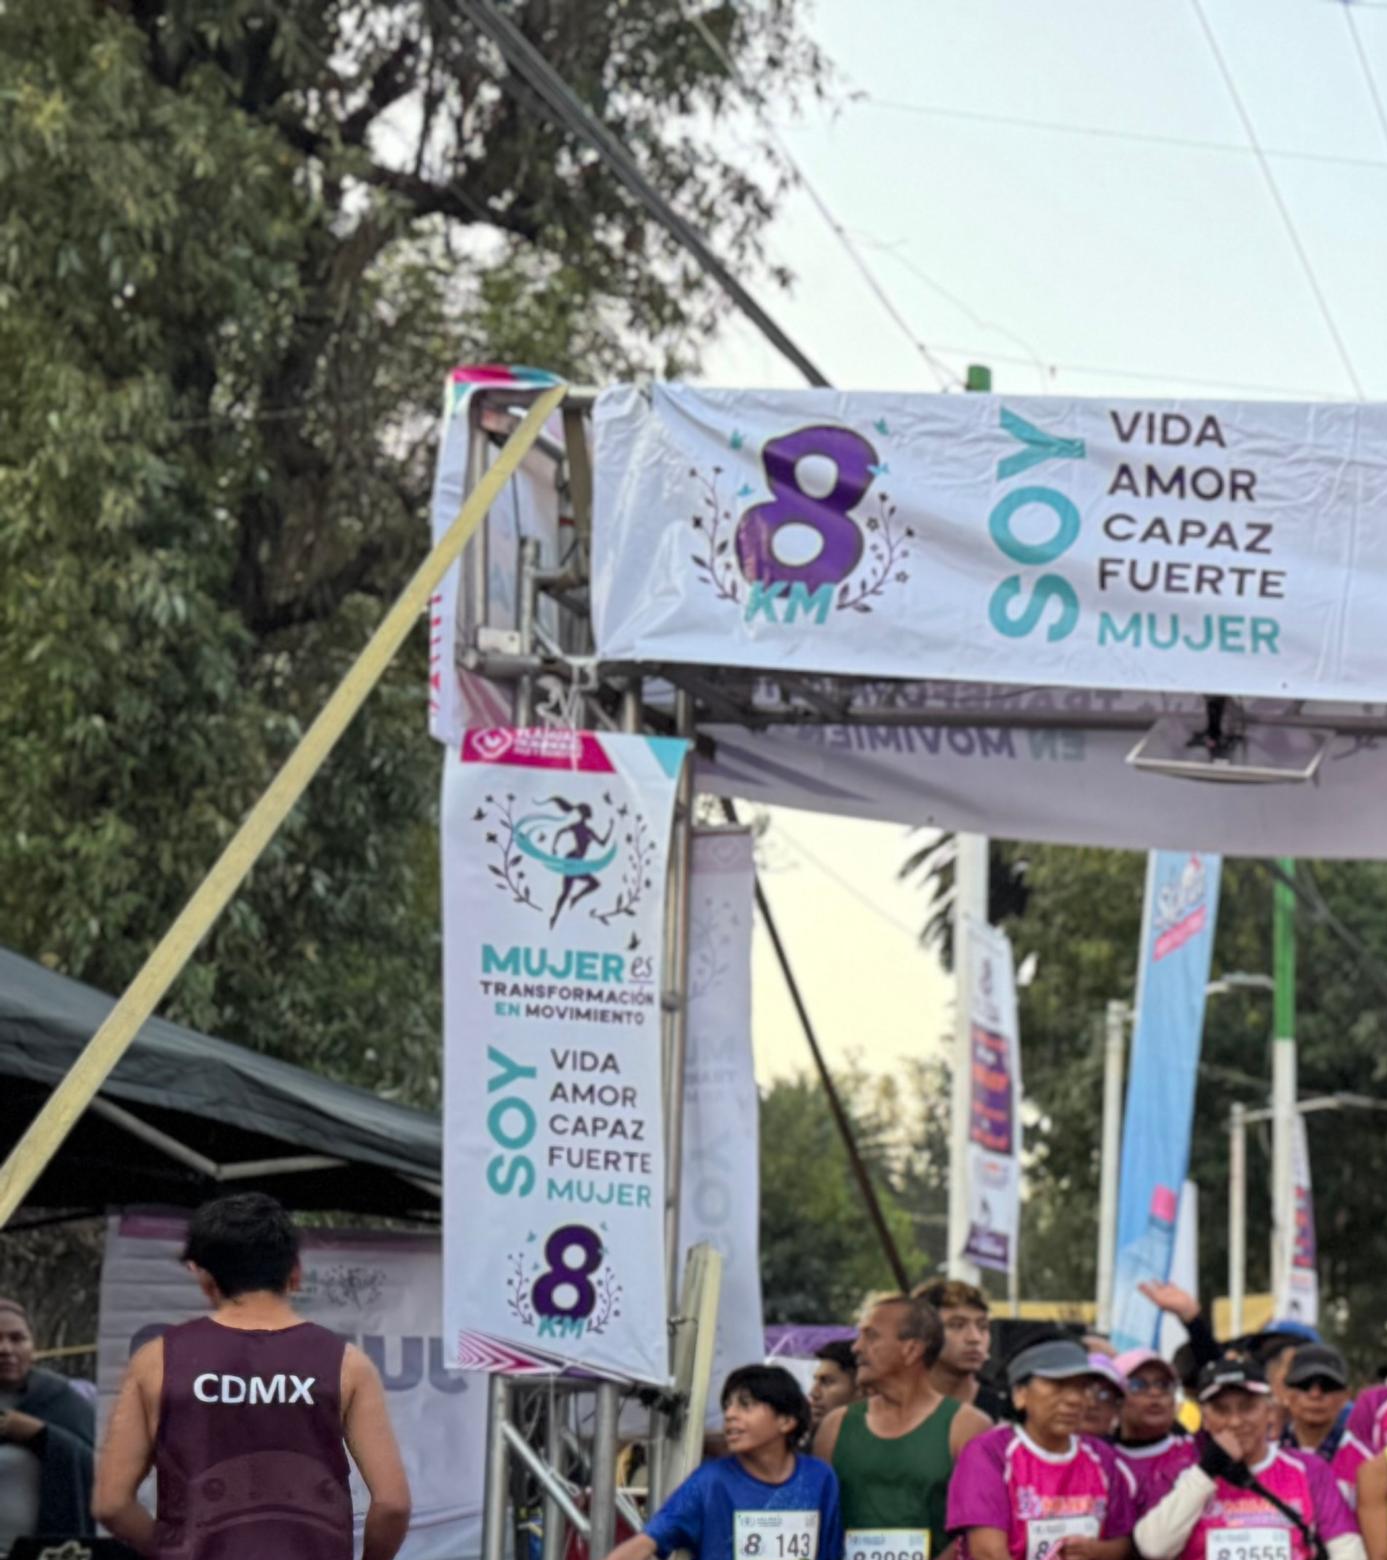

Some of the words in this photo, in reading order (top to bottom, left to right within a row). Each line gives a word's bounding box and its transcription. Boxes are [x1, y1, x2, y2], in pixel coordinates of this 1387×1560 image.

[1110, 410, 1227, 449] VIDA
[1107, 463, 1258, 503] AMOR
[734, 424, 879, 592] 8
[989, 408, 1086, 643] SOY
[1103, 511, 1274, 556] CAPAZ
[1096, 558, 1288, 600] FUERTE
[744, 582, 834, 625] KM
[1096, 611, 1282, 656] MUJER
[480, 943, 625, 984] MUJER
[628, 955, 654, 980] es
[480, 980, 655, 1007] TRANSFORMACIÓN
[494, 1002, 521, 1018] EN
[525, 1004, 645, 1026] MOVIMIENTO
[549, 1048, 621, 1075] VIDA
[549, 1082, 638, 1109] AMOR
[487, 1045, 537, 1199] SOY
[549, 1113, 645, 1141] CAPAZ
[548, 1145, 652, 1174] FUERTE
[547, 1178, 652, 1207] MUJER
[531, 1223, 603, 1323] 8
[537, 1315, 585, 1340] KM
[193, 1373, 316, 1406] CDMX
[744, 1533, 762, 1556] 8
[776, 1533, 811, 1558] 143
